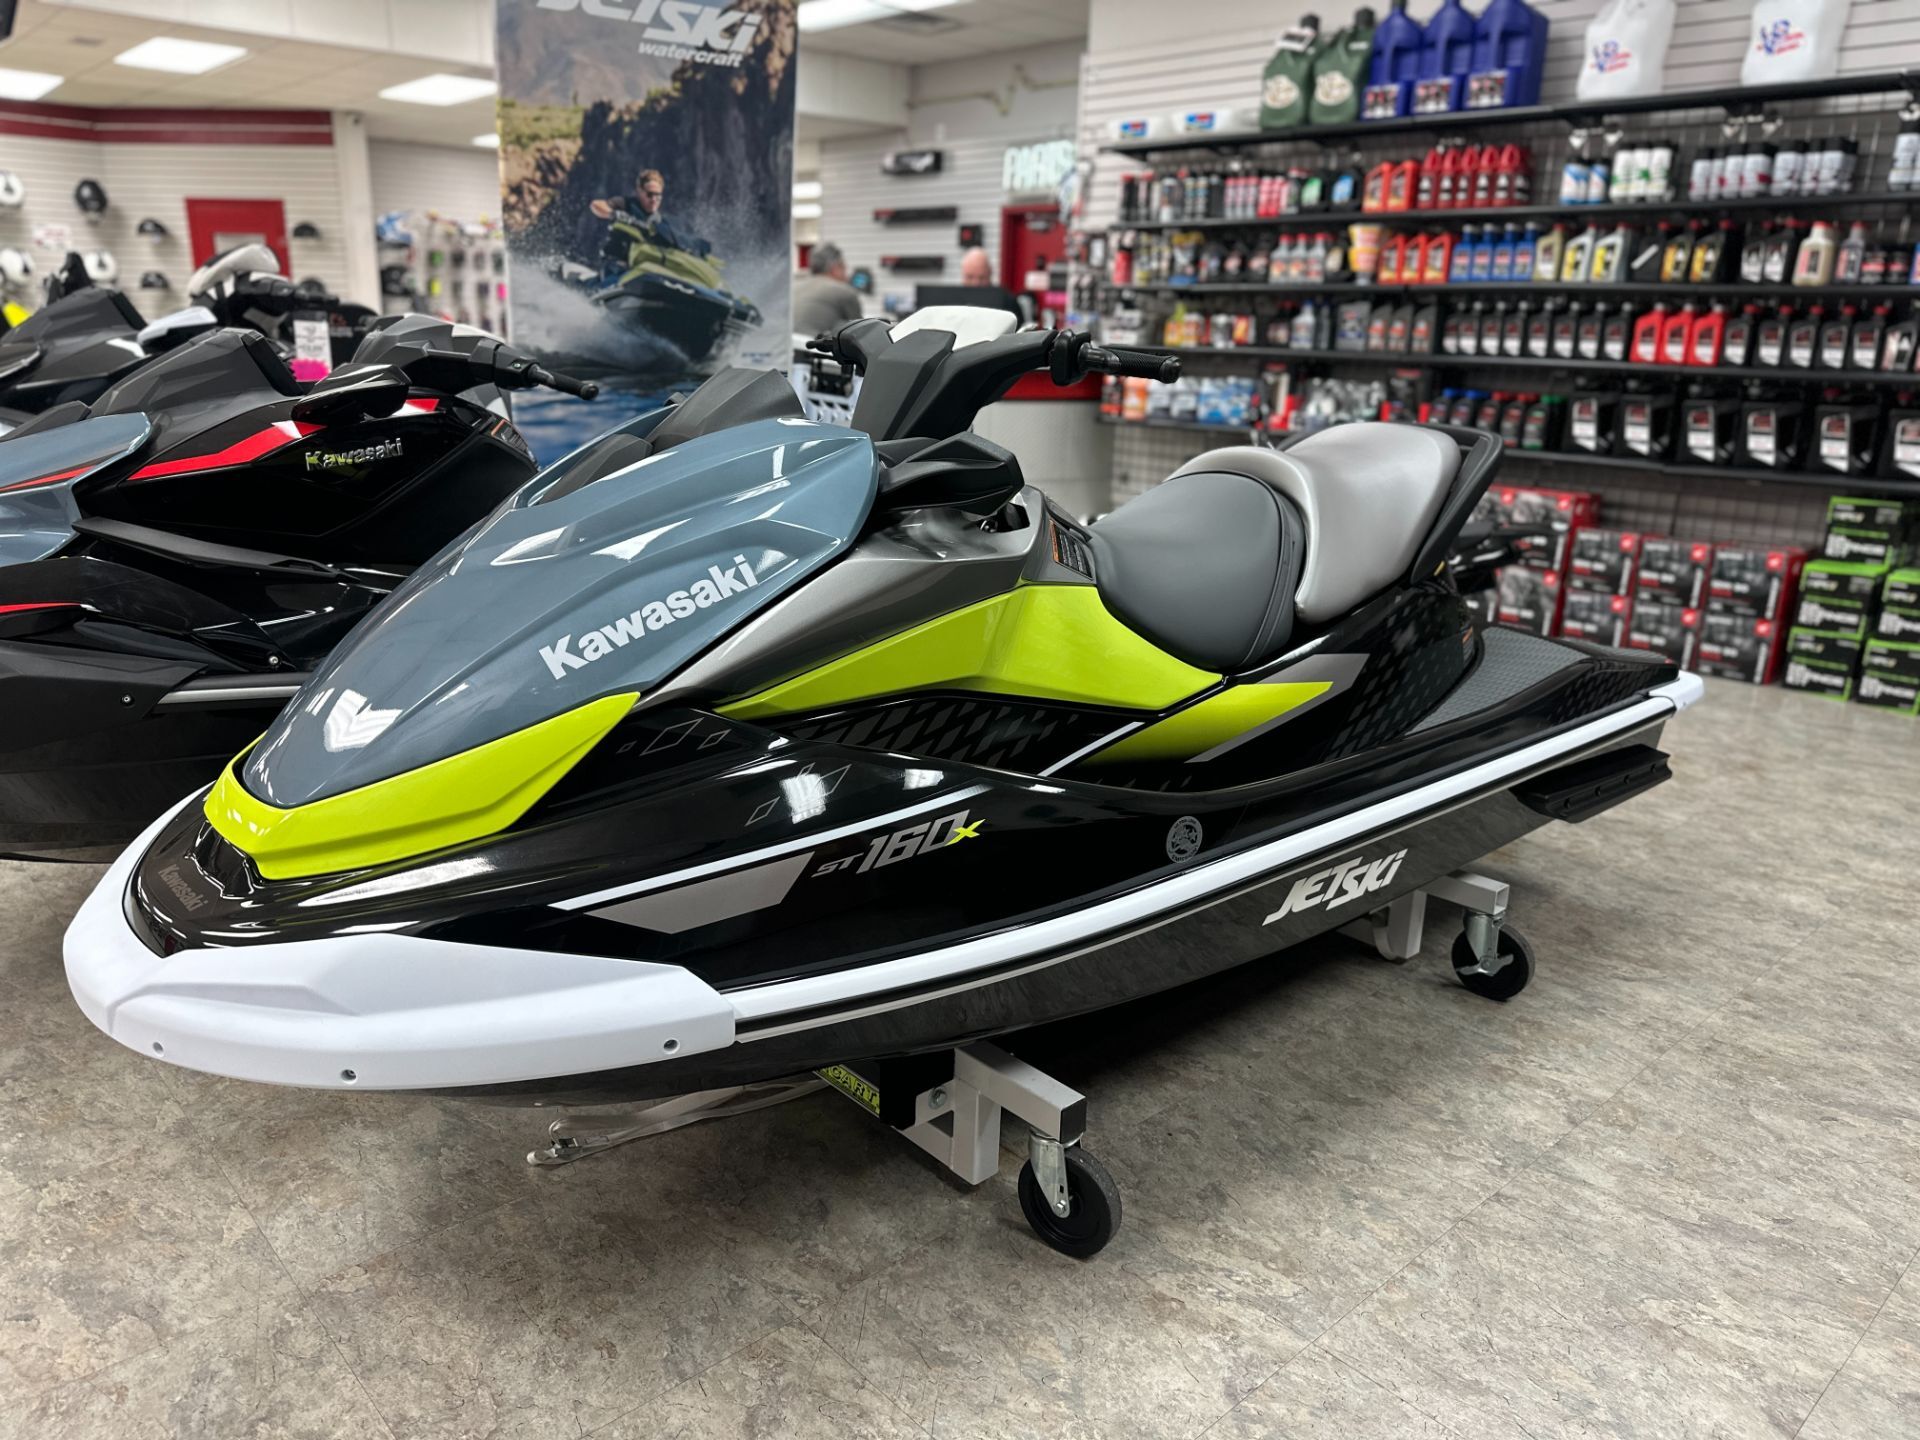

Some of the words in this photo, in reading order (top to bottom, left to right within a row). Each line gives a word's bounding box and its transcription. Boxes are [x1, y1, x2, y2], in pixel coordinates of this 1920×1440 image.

[638, 41, 744, 68] watercraft
[305, 437, 403, 472] Kawasaki
[539, 554, 759, 680] Kawasaki
[158, 863, 209, 911] Kawasaki
